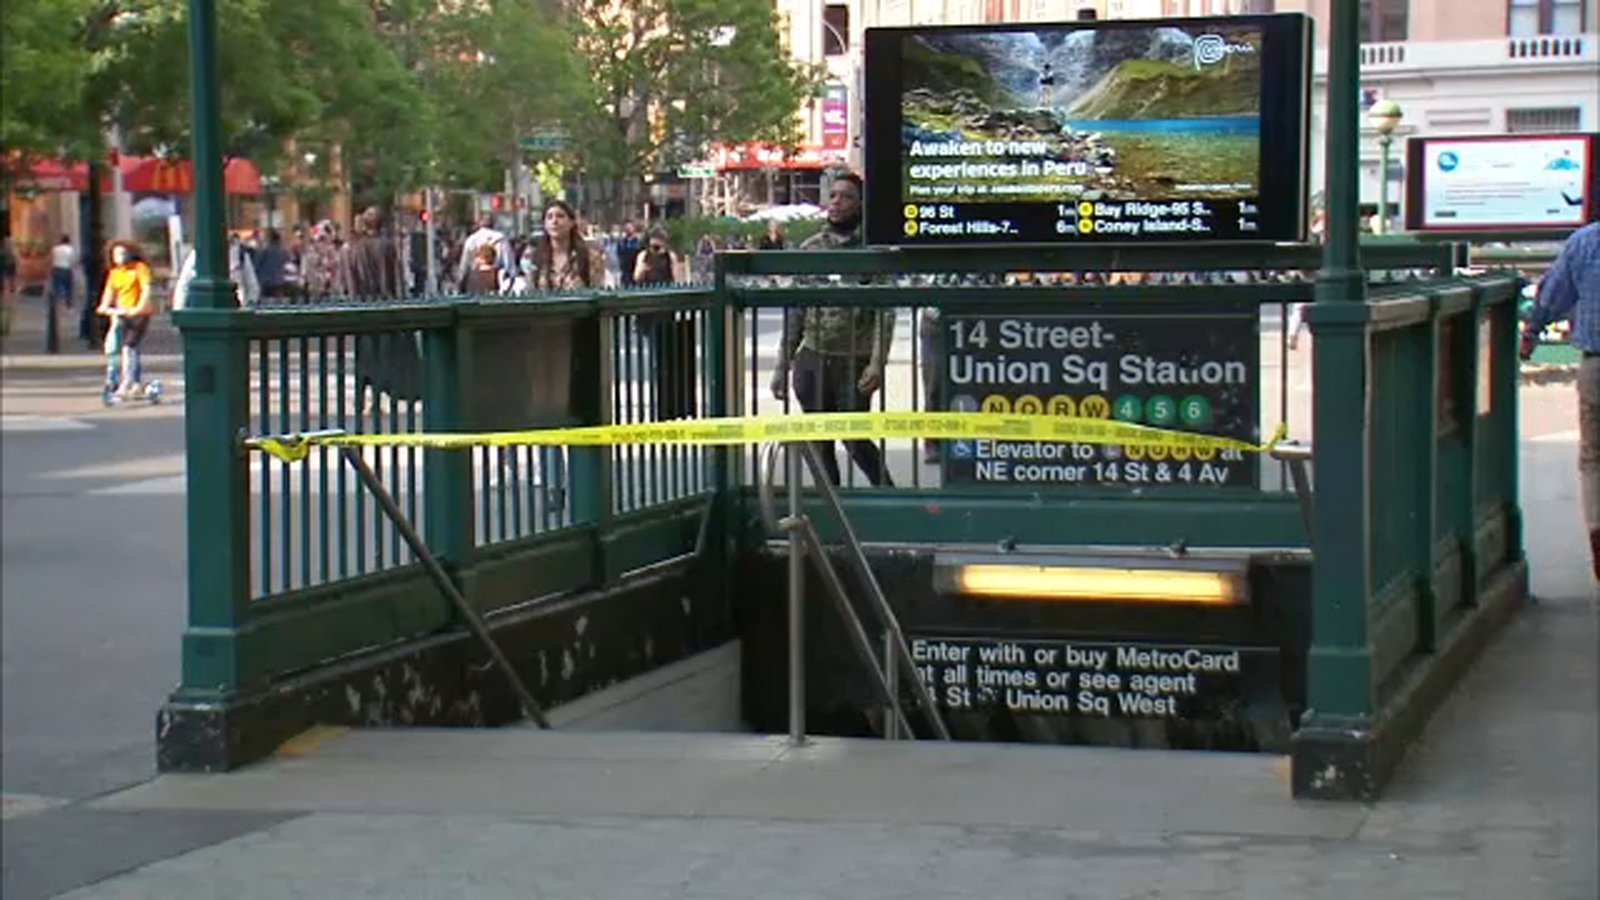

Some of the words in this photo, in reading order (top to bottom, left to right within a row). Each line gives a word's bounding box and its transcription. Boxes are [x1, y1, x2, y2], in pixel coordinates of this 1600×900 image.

[910, 141, 982, 156] Awaken
[986, 140, 1001, 155] to
[1009, 140, 1047, 156] new
[910, 162, 1017, 180] experiences
[1022, 160, 1039, 175] in
[1044, 160, 1086, 175] Peru
[920, 206, 935, 218] 96
[939, 205, 954, 218] St
[1095, 203, 1121, 217] Bay
[919, 221, 963, 234] Forest
[1095, 219, 1140, 234] Coney
[949, 320, 989, 348] 14
[999, 319, 1115, 349] Street-
[949, 356, 1050, 384] Union
[1062, 354, 1109, 390] Sq
[976, 440, 1065, 459] Elevator
[1071, 441, 1094, 459] to
[1220, 446, 1243, 461] at
[976, 462, 1008, 480] NE
[1014, 463, 1086, 482] corner
[1093, 463, 1118, 481] 14
[1124, 463, 1149, 482] St
[1154, 463, 1171, 481] &
[1178, 463, 1192, 482] 4
[1200, 463, 1229, 482] Av
[912, 639, 970, 661] Enter
[979, 642, 1026, 664] with
[1034, 646, 1057, 664] or
[1066, 645, 1107, 670] buy
[1116, 648, 1239, 671] MetroCard
[943, 665, 967, 684] all
[976, 665, 1036, 687] times
[1046, 673, 1071, 689] or
[1079, 673, 1121, 690] see
[1130, 675, 1196, 694] agent
[946, 686, 971, 706] St
[1006, 689, 1069, 711] Union
[1077, 691, 1109, 716] Sq
[1119, 692, 1177, 714] West
